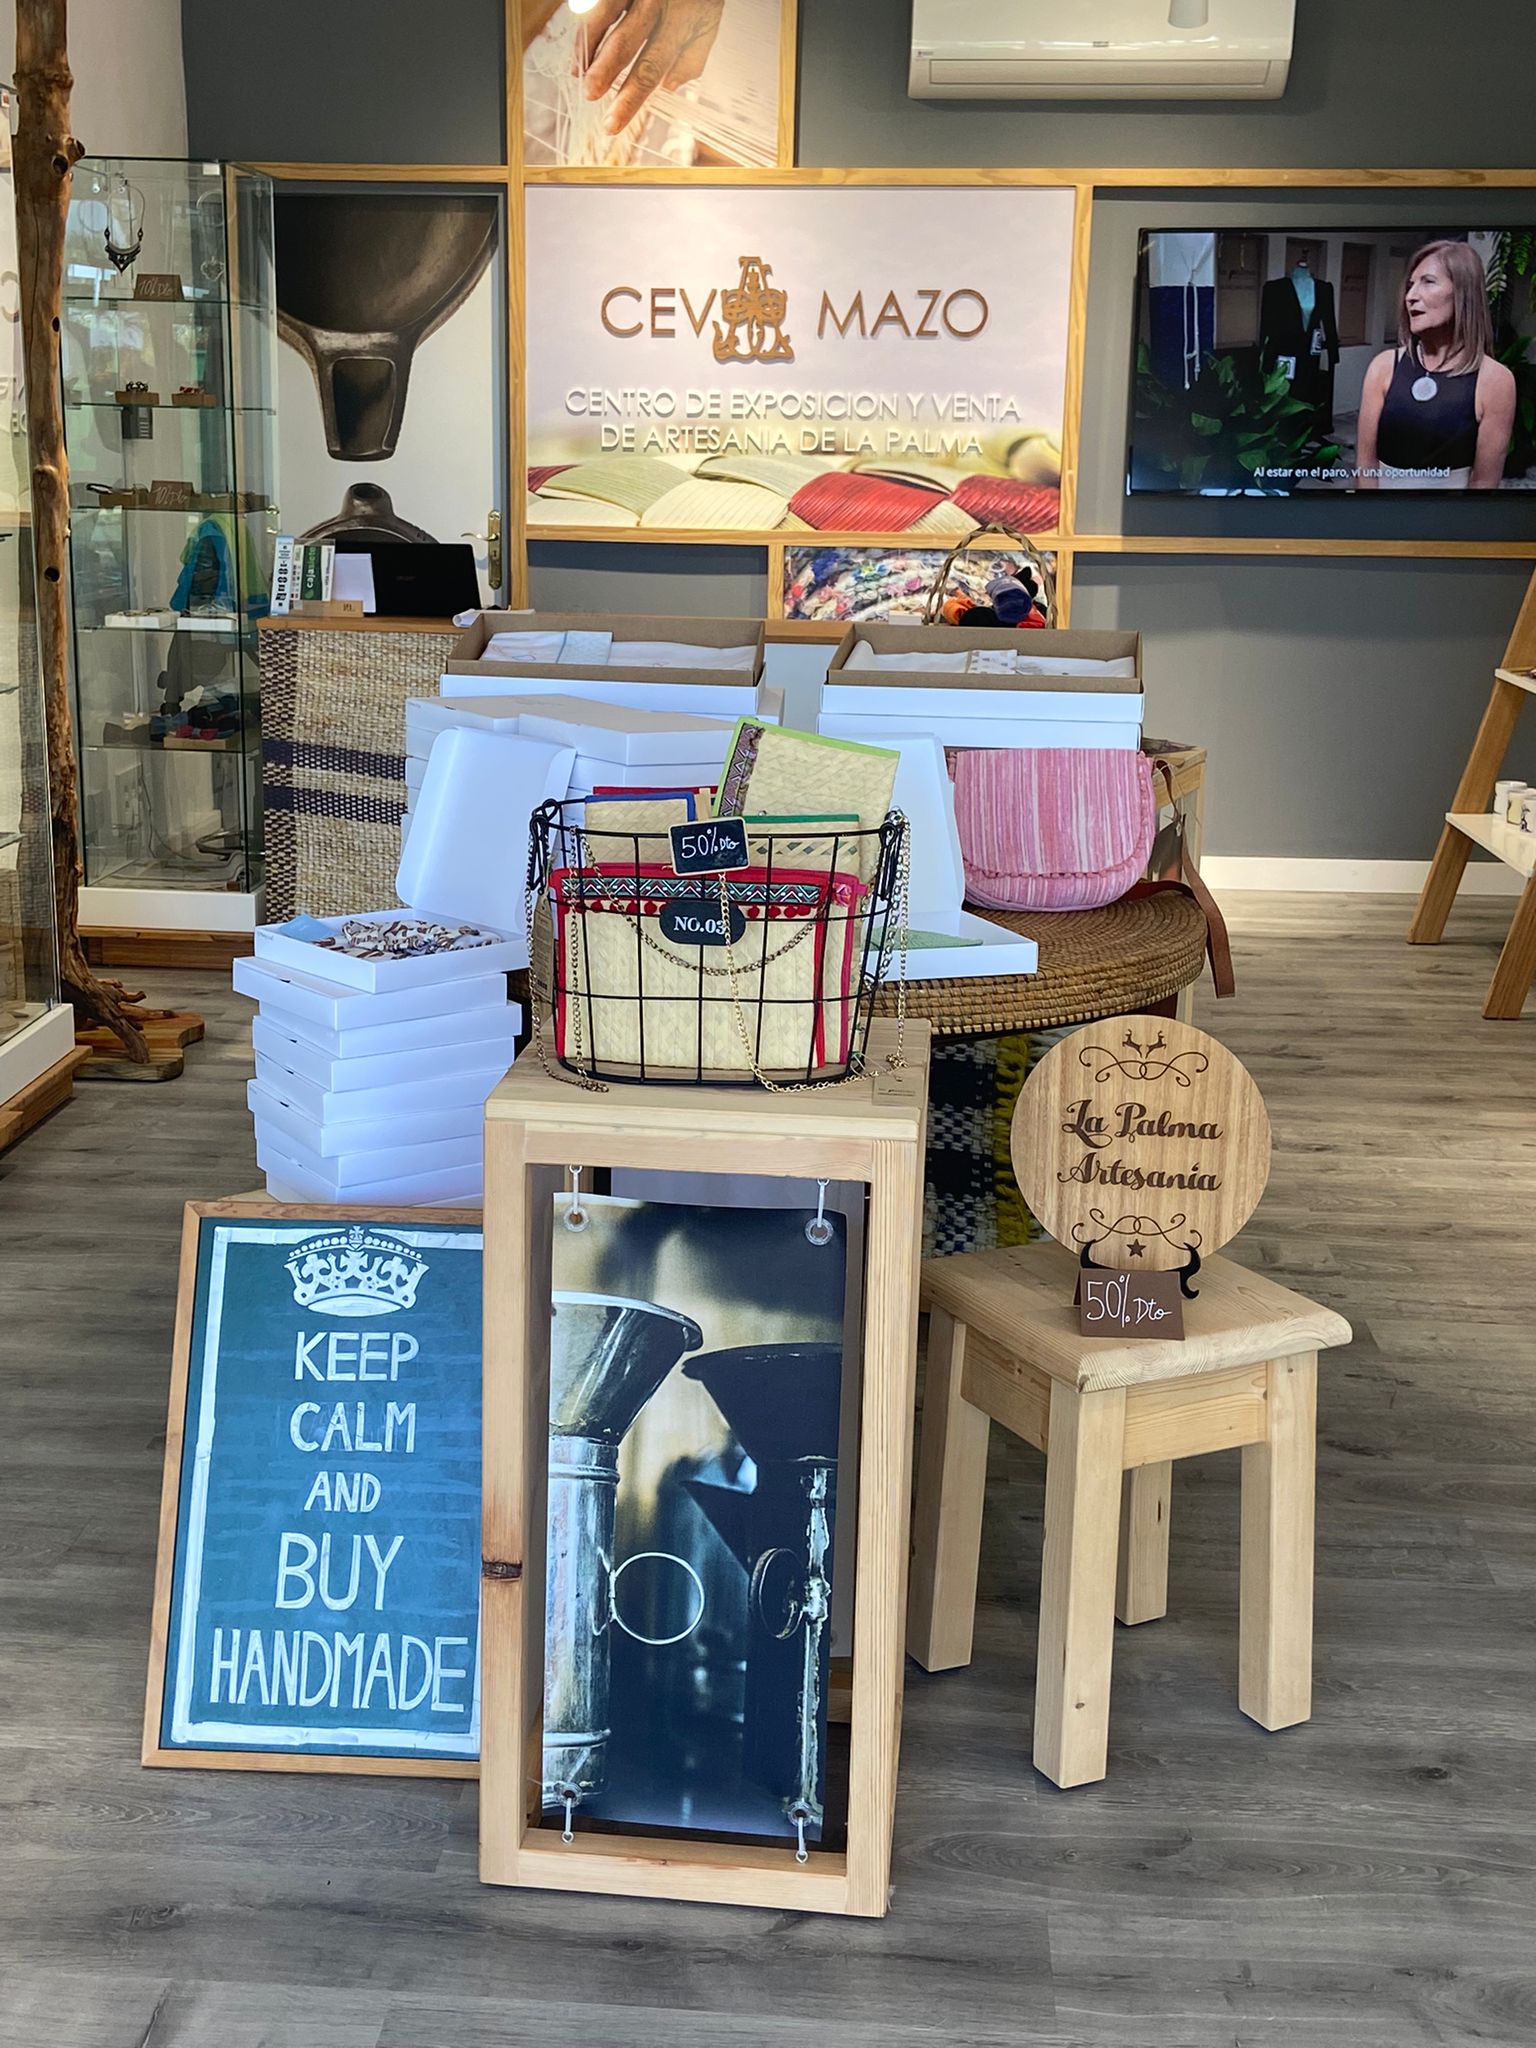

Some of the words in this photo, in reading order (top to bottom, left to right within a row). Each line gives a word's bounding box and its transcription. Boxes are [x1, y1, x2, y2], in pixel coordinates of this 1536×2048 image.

[601, 286, 718, 339] CEV
[817, 288, 989, 339] MAZO
[565, 386, 677, 418] CENTRO
[686, 388, 721, 419] DE
[730, 388, 898, 421] EXPOSICION
[906, 392, 926, 420] Y
[932, 393, 1022, 422] VENTA
[601, 424, 635, 452] DE
[643, 424, 792, 455] ARTESANIA
[799, 427, 836, 454] DE
[843, 427, 877, 456] LA
[886, 428, 984, 456] PALMA
[1253, 467, 1265, 477] Al
[1266, 468, 1294, 478] estar
[1295, 470, 1308, 478] en
[1310, 467, 1321, 477] el
[1322, 468, 1350, 480] paro,
[1362, 468, 1382, 478] una
[1384, 467, 1450, 480] oportunidad
[681, 826, 719, 859] 50%
[719, 835, 740, 851] Dto
[1061, 1099, 1113, 1149] La
[1115, 1102, 1224, 1143] Palma
[1057, 1151, 1222, 1191] Artesanía
[1086, 1273, 1131, 1328] 50%
[1133, 1298, 1173, 1325] Dto
[294, 1331, 420, 1382] KEEP
[289, 1401, 417, 1454] CALM
[303, 1471, 382, 1513] AND
[274, 1532, 405, 1612] BUY
[209, 1627, 469, 1713] HANDMADE
